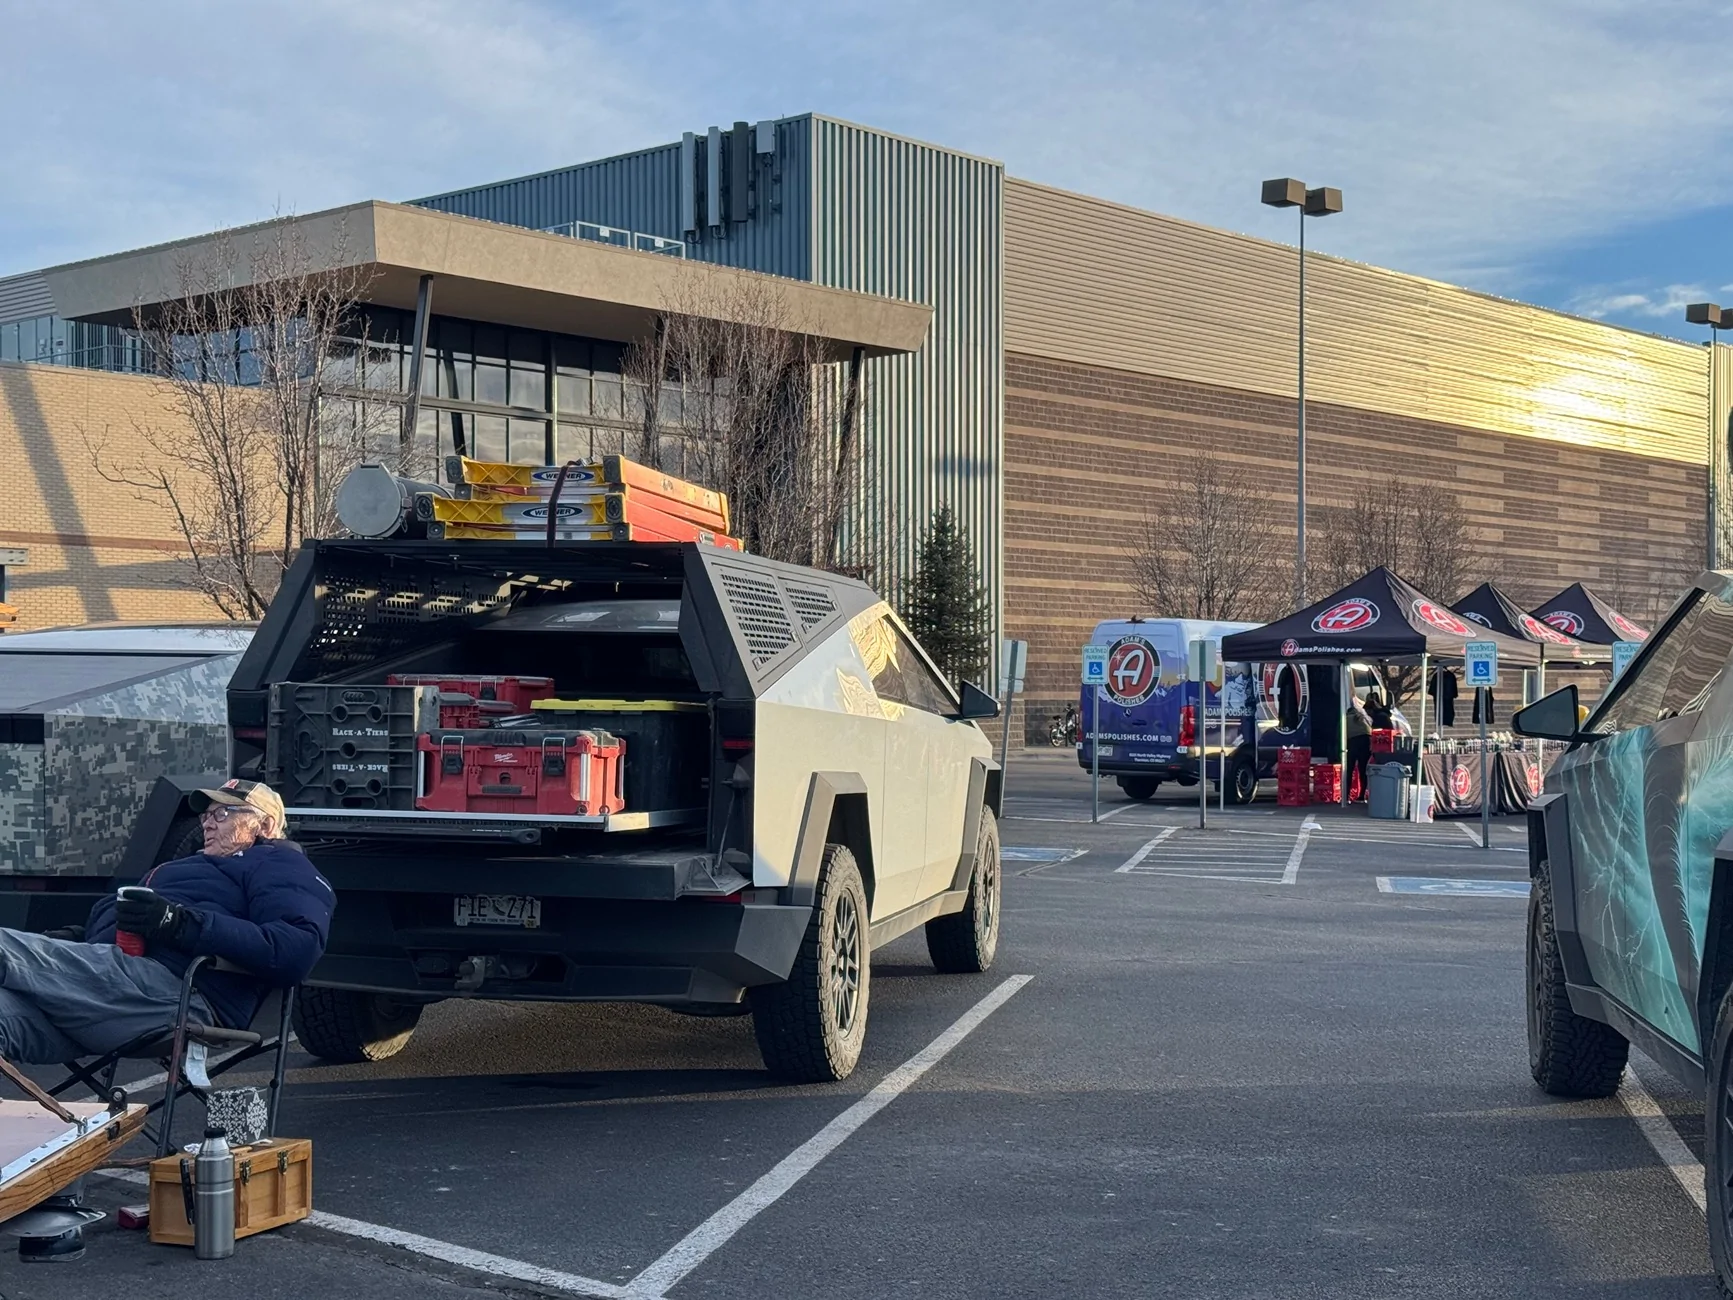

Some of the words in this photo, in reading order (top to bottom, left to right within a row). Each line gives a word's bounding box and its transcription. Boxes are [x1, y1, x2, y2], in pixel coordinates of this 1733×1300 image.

[534, 508, 572, 516] WENER
[1120, 636, 1146, 645] ADAM'S
[1113, 649, 1145, 691] A
[1112, 694, 1145, 705] POLISHES
[1085, 732, 1159, 742] ADMSPOLISHES.COM
